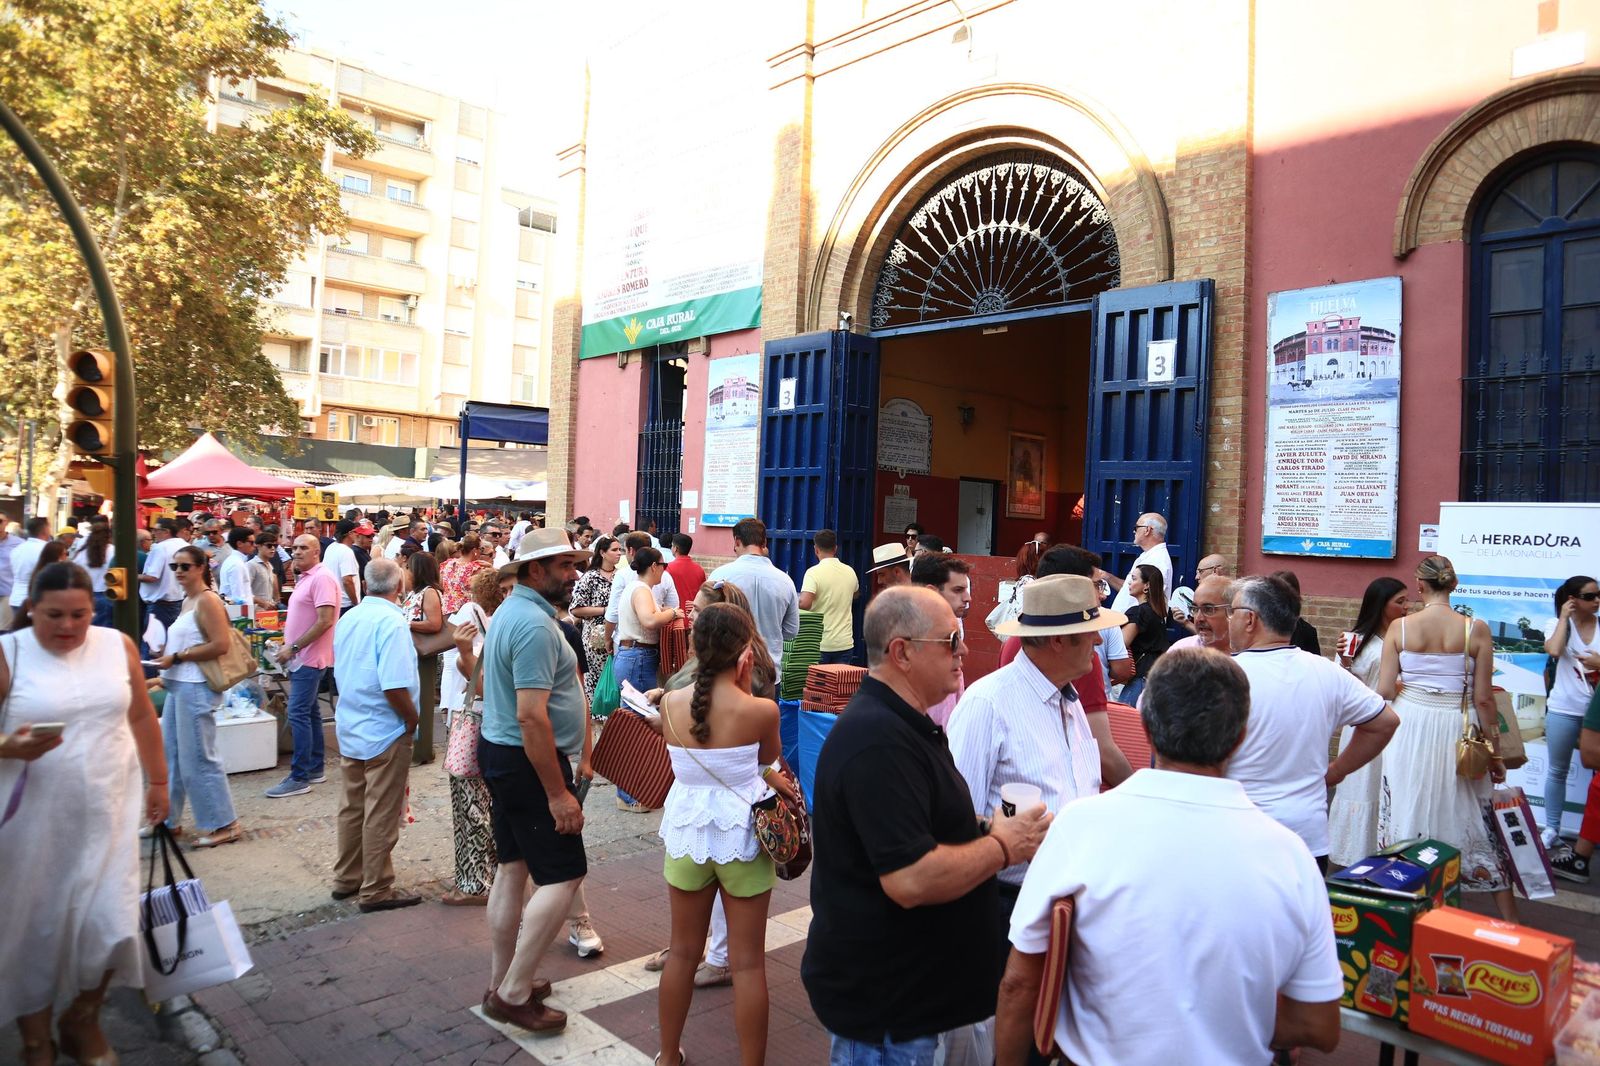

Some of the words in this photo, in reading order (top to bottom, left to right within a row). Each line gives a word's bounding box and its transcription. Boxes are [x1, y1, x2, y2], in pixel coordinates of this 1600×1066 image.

[622, 277, 649, 294] ROMERO
[1310, 297, 1357, 314] HUELVA
[646, 316, 666, 330] CAJA
[666, 310, 695, 326] RURAL
[1154, 356, 1166, 376] 3
[783, 390, 791, 406] 3
[1461, 533, 1478, 545] LA
[1482, 533, 1582, 548] HERRADURA
[1477, 548, 1489, 557] DE
[1491, 549, 1503, 557] LA
[1504, 549, 1562, 559] MONACILLA
[1483, 588, 1511, 596] sueños
[1468, 966, 1531, 994] Reyes
[1422, 999, 1448, 1016] PIPAS
[1450, 1008, 1483, 1027] RECIÉN
[1485, 1020, 1534, 1046] TOSTADAS
